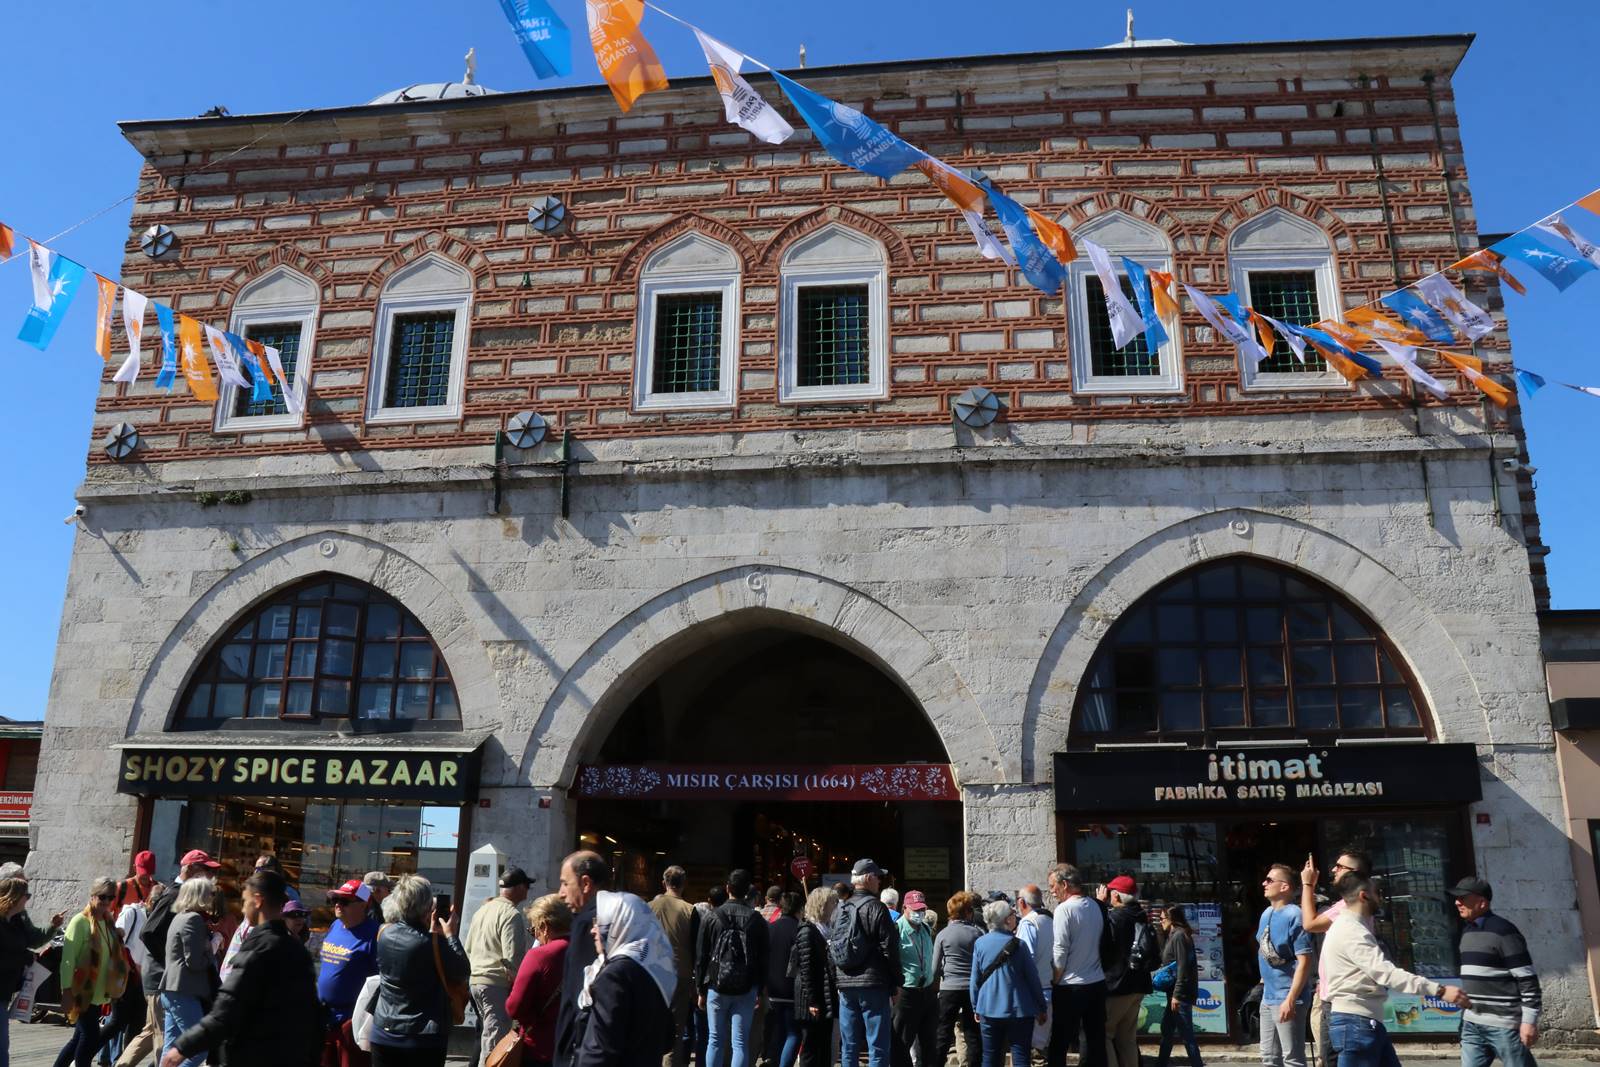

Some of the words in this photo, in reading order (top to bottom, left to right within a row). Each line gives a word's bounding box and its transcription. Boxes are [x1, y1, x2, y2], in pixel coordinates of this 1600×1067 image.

[851, 146, 866, 160] AK
[124, 755, 226, 782] SHOZY
[232, 757, 317, 784] SPICE
[325, 758, 458, 786] BAZAAR
[1208, 752, 1323, 782] itimat
[667, 774, 720, 787] MISIR
[725, 774, 799, 790] ÇARŞISI
[804, 774, 855, 790] (1664)
[1154, 783, 1227, 801] FABRİKA
[1237, 784, 1286, 801] SATIŞ
[1296, 780, 1383, 798] MAĞAZASI
